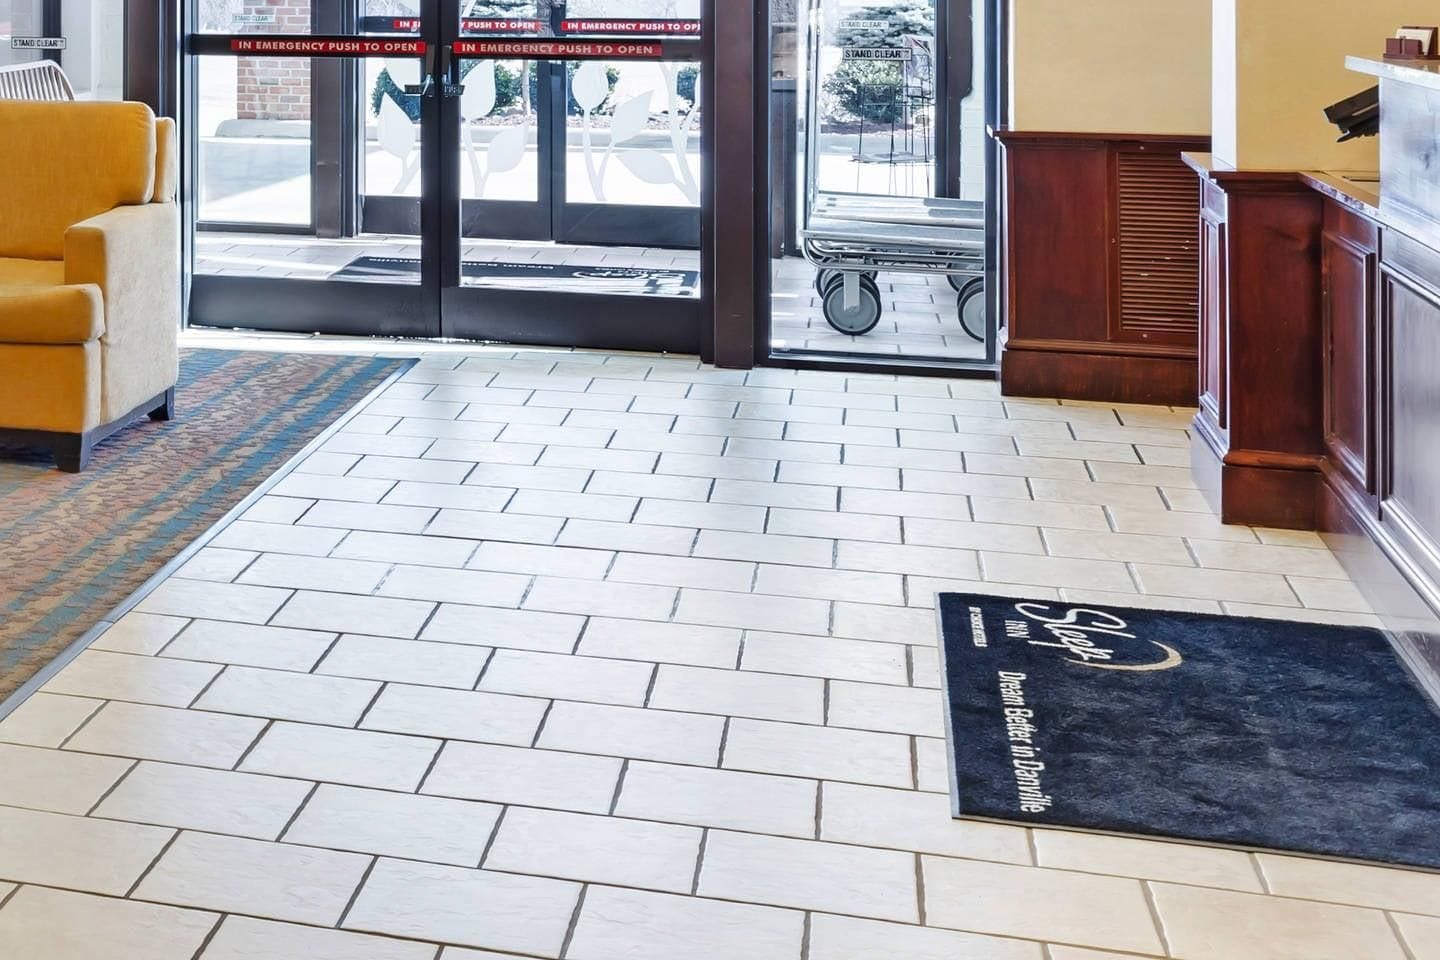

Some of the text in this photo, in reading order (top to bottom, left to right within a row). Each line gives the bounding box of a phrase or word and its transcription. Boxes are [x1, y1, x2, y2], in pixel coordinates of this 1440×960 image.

[467, 21, 492, 29] PUSH
[494, 21, 506, 29] TO
[509, 22, 535, 30] OPEN
[567, 21, 701, 31] IN EMERGENCY PUSH TO OP
[13, 39, 35, 47] STAND
[37, 39, 58, 47] CLEAR
[238, 40, 417, 52] IN EMERGENCY PUSH TO OPEN
[461, 43, 653, 54] IN EMERGENCY PUSH TO OPEN
[845, 50, 872, 58] STAND
[874, 50, 901, 58] CLEAR
[1004, 619, 1031, 639] INN
[1014, 602, 1137, 661] Sleep
[997, 670, 1053, 814] Dream Better in Danville
